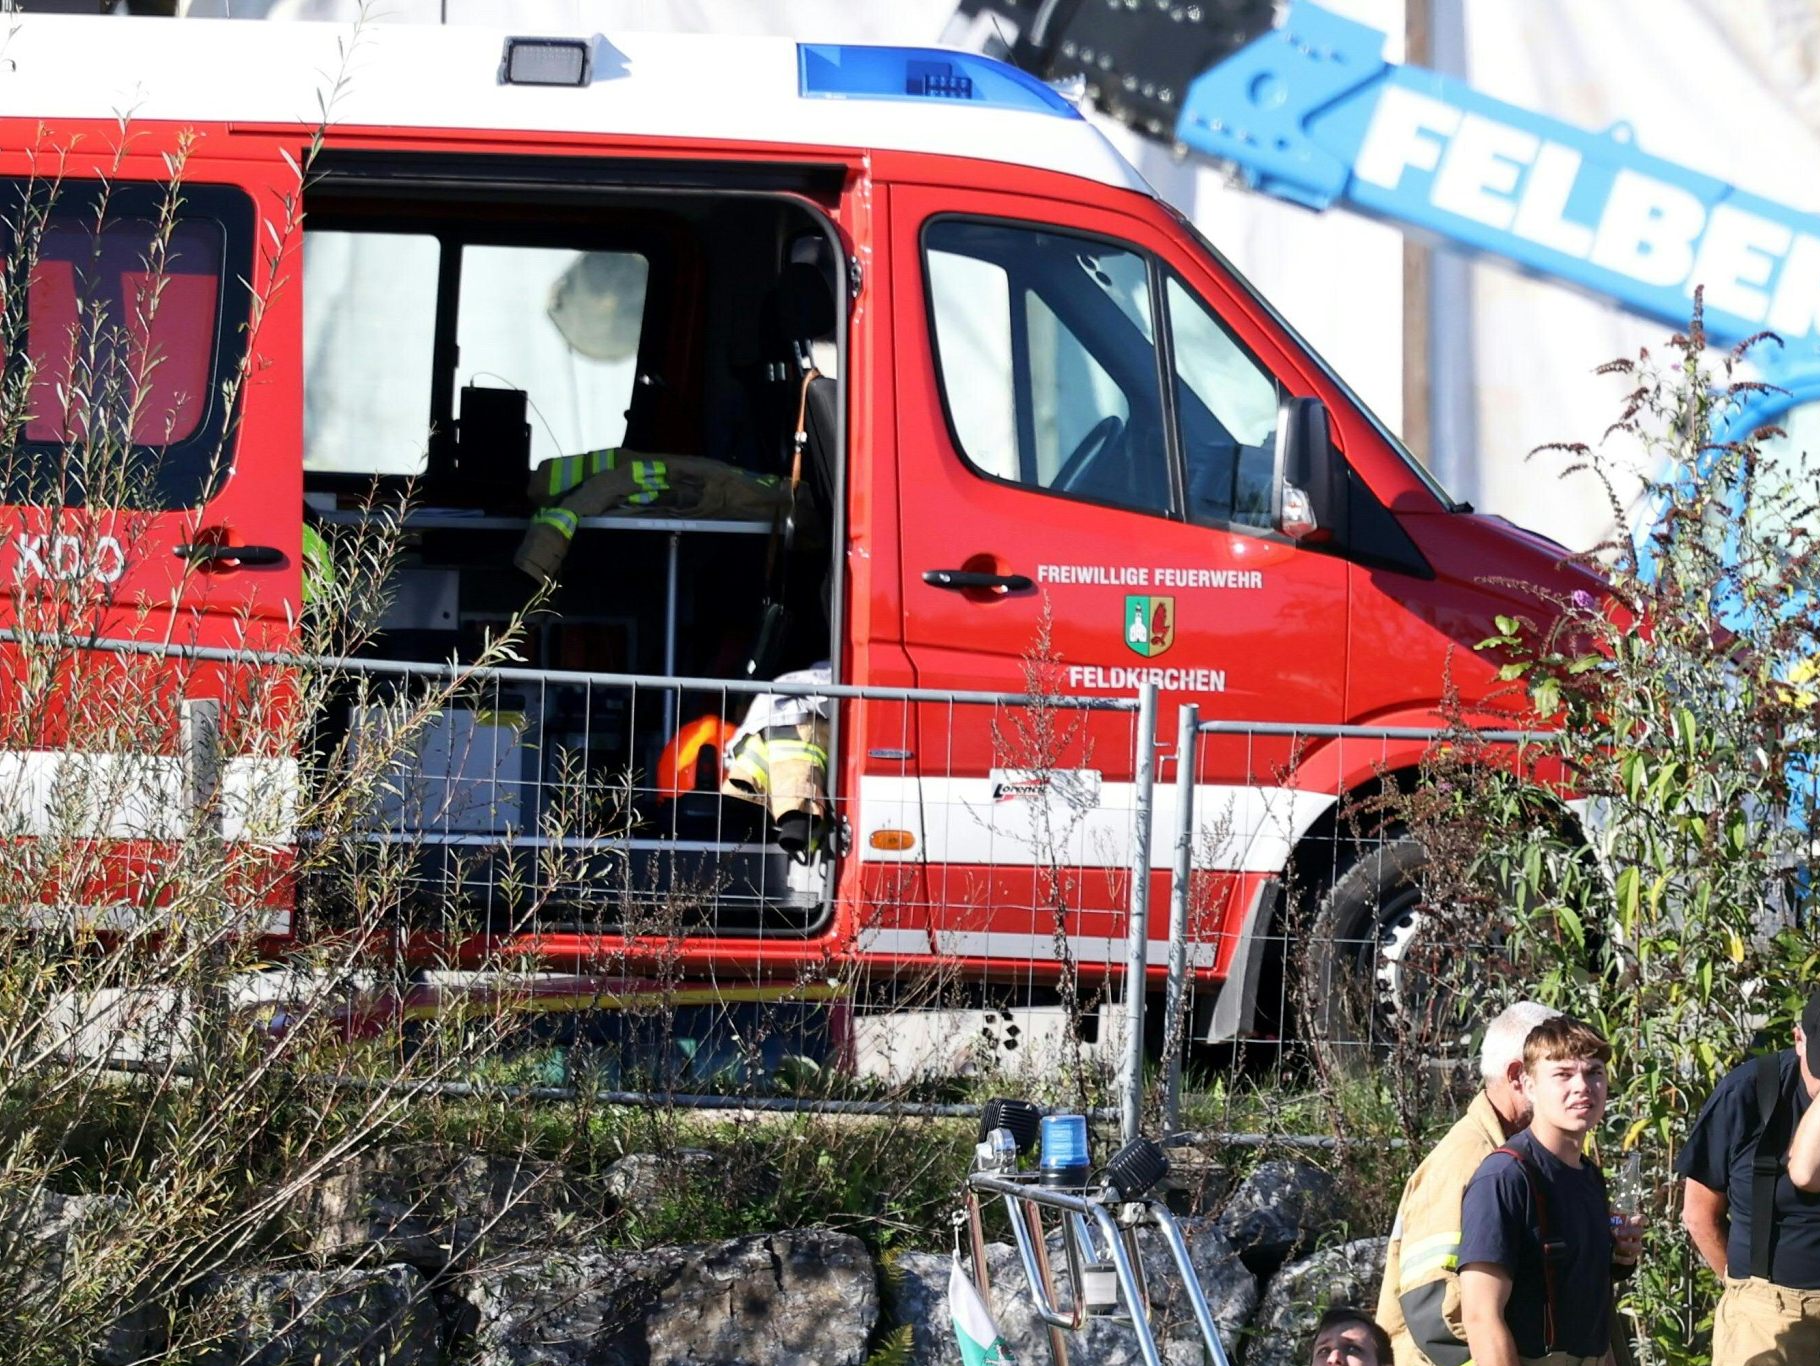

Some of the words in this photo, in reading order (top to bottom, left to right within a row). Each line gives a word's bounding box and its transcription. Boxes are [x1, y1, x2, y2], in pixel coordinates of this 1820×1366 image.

[1037, 565, 1148, 585] FREIWILLIGE
[1155, 568, 1262, 588] FEUERWEHR
[1069, 666, 1225, 692] FELDKIRCHEN
